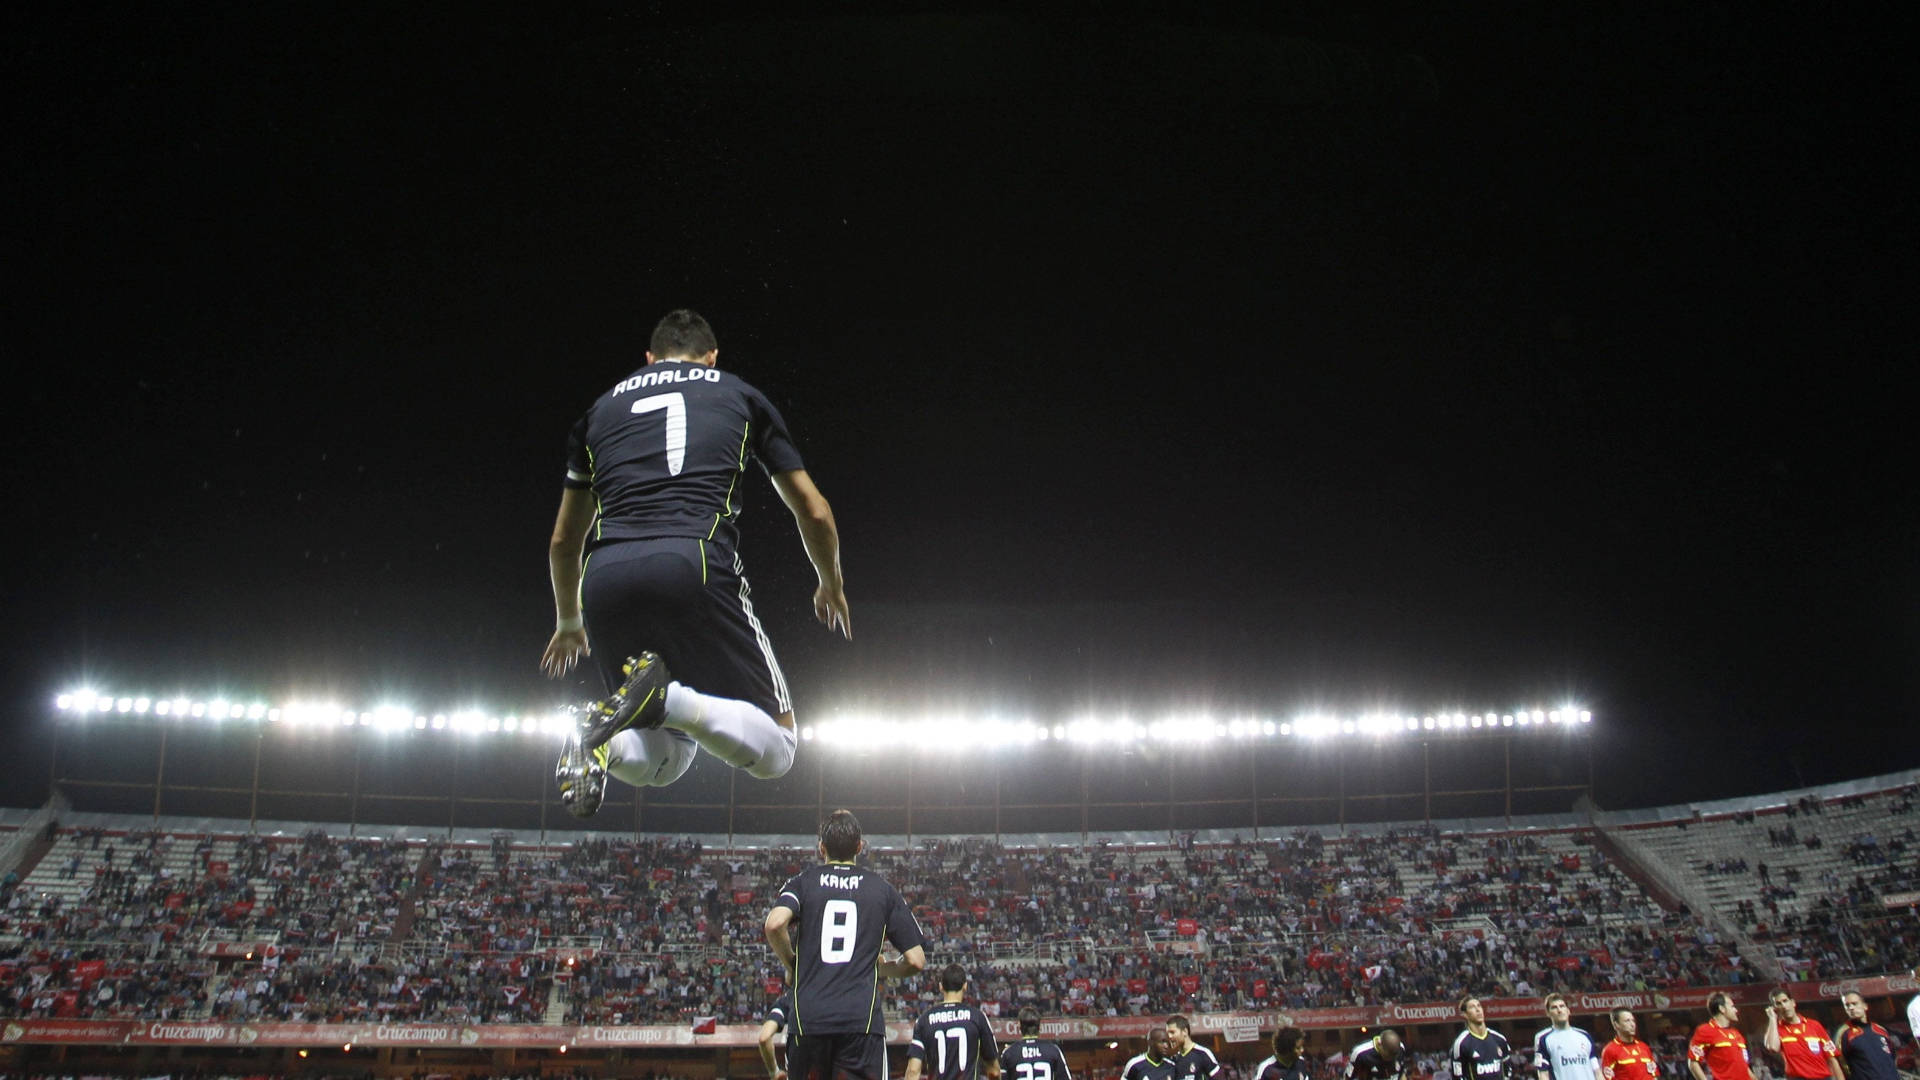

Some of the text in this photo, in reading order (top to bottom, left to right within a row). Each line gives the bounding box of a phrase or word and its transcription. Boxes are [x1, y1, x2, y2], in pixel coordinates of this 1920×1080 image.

[612, 368, 720, 398] RONALDO
[630, 392, 687, 476] 7
[820, 899, 858, 963] 8
[1582, 995, 1642, 1010] Cruzcampo
[928, 1010, 971, 1025] ARBELOA
[1394, 1006, 1456, 1020] Cruzcampo
[150, 1023, 225, 1042] Cruzcampo
[376, 1025, 447, 1043] Cruzcampo
[594, 1027, 662, 1044] Cruzcampo
[1006, 1021, 1070, 1036] Crampo
[934, 1027, 968, 1074] 17
[1022, 1046, 1042, 1058] ÖZIL
[1561, 1054, 1587, 1066] bwin
